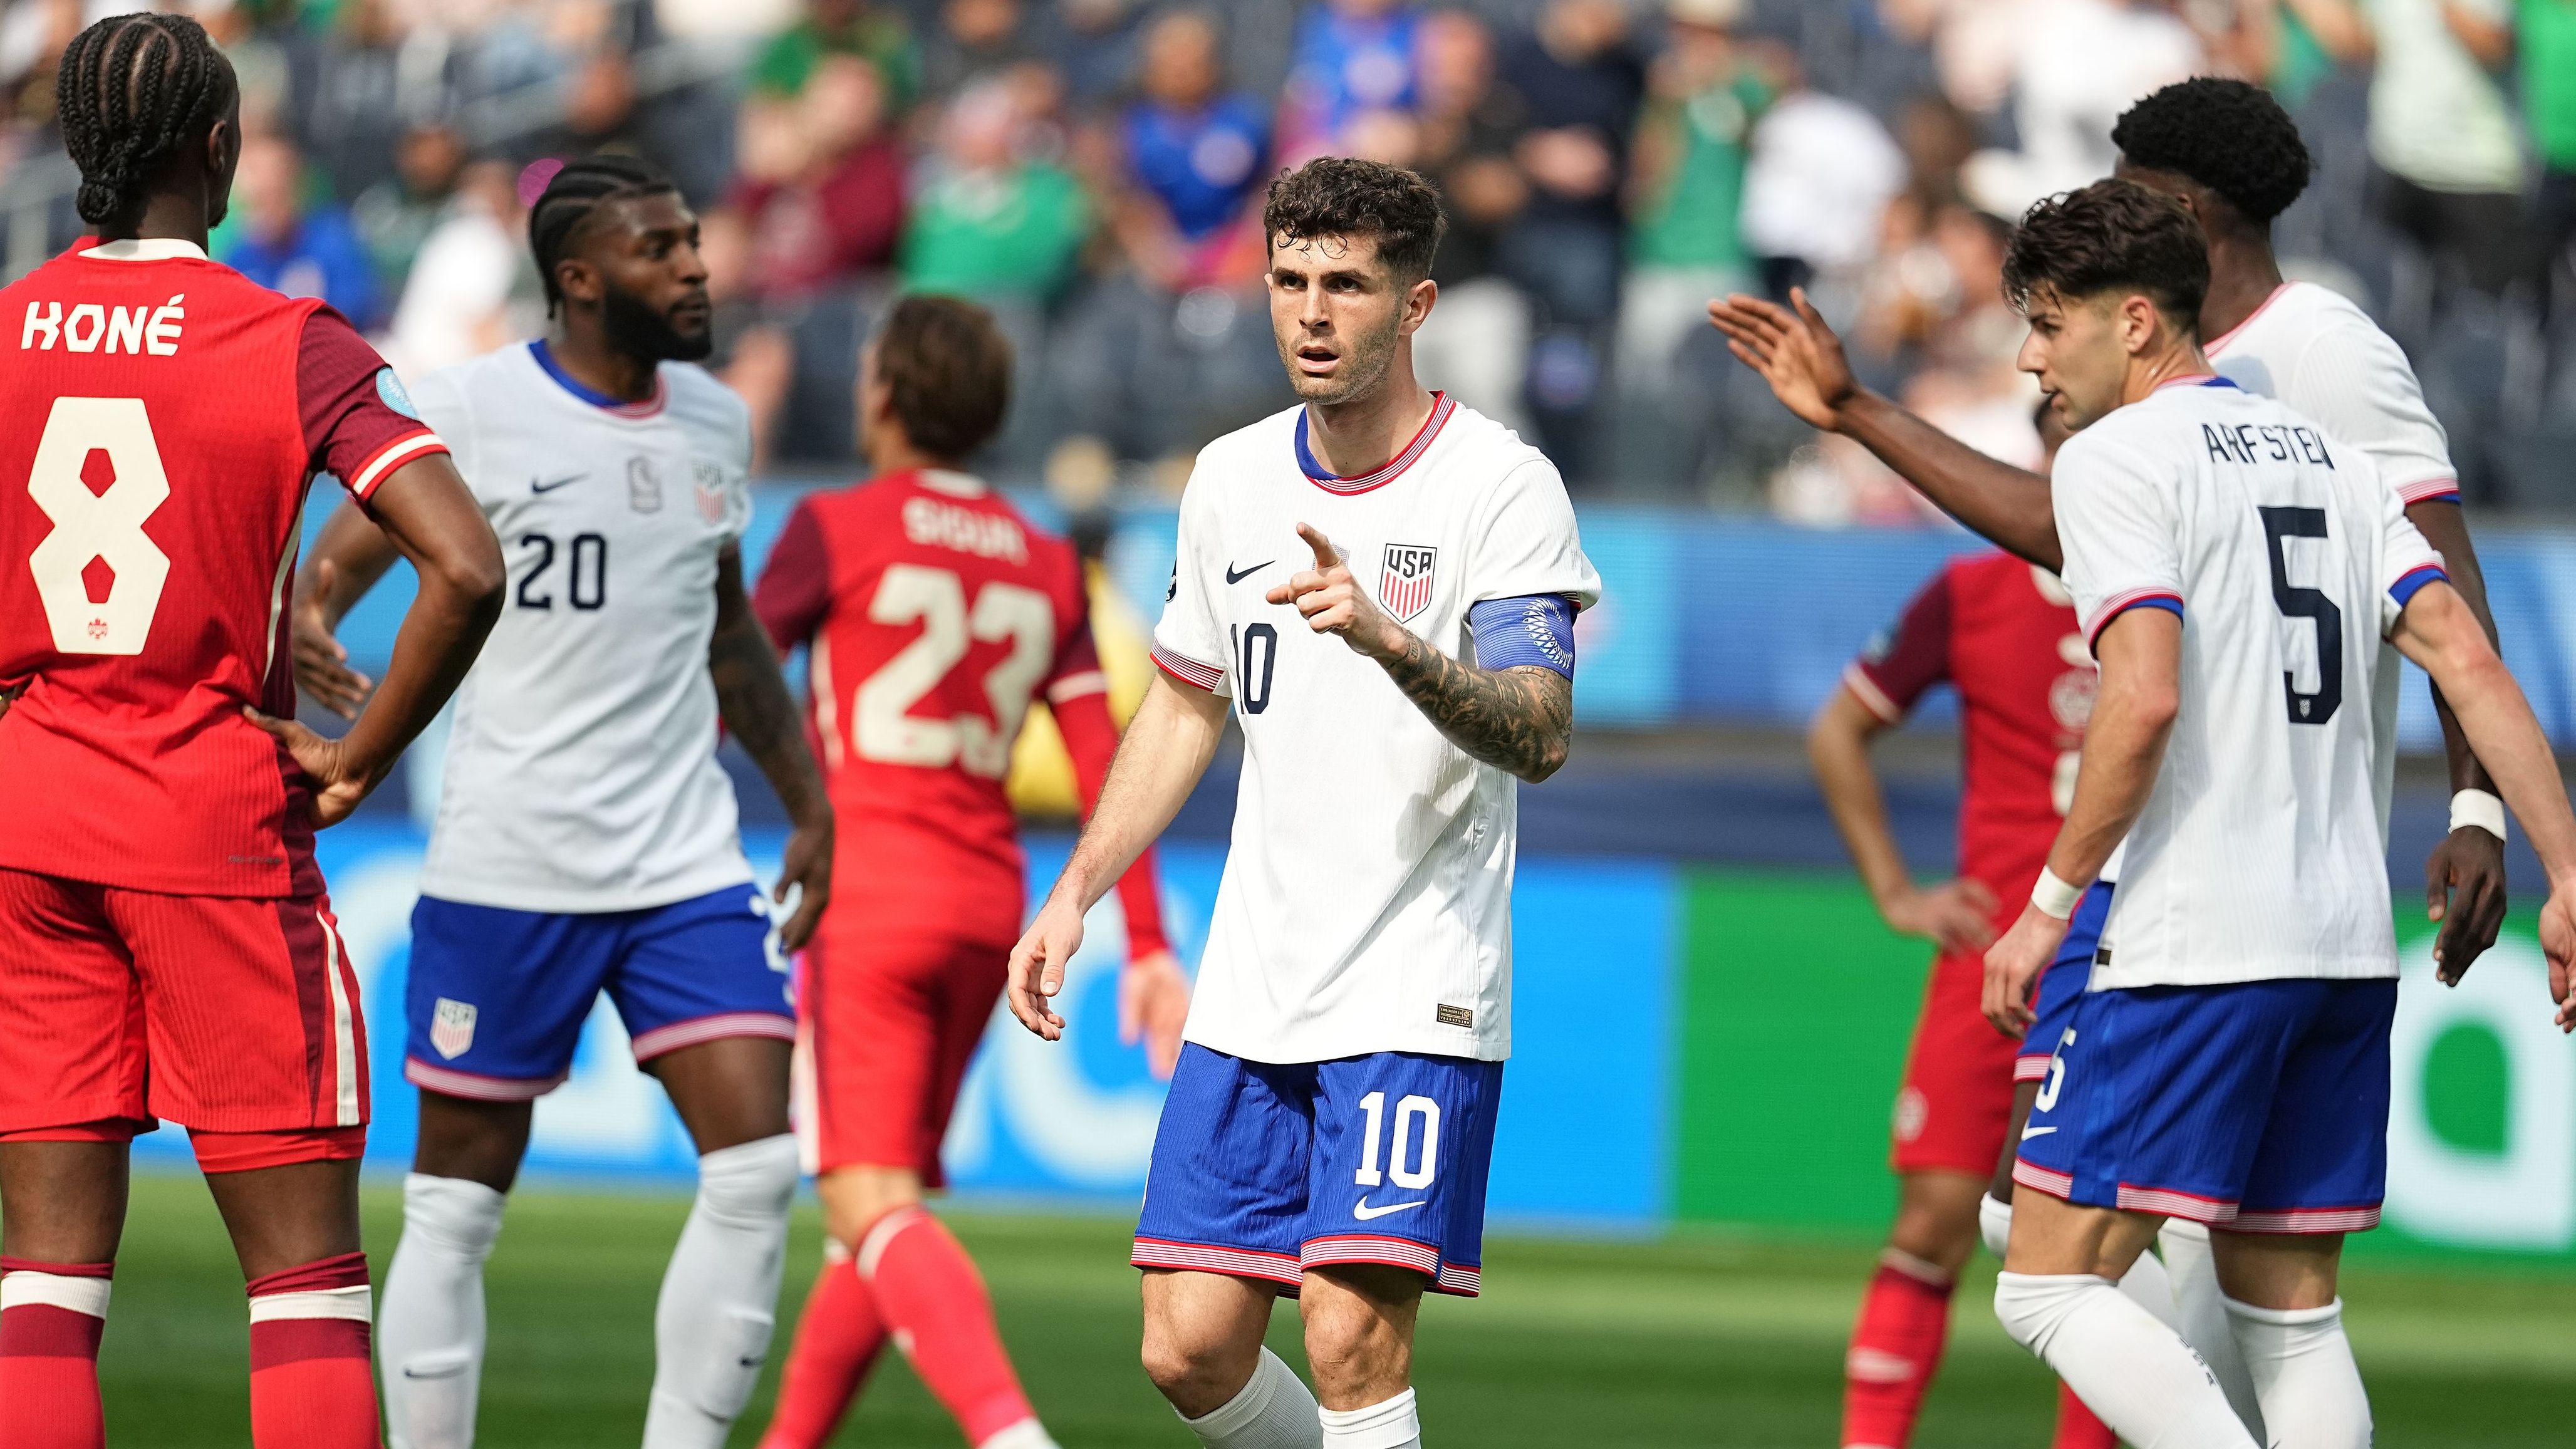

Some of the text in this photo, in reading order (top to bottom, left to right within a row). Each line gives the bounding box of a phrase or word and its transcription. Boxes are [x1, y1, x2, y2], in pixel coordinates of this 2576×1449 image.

[21, 293, 185, 356] KONÉ
[2201, 423, 2335, 470] ARFSTEN
[28, 397, 170, 655] 8
[1388, 549, 1432, 578] USA
[518, 534, 605, 610] 20
[2257, 506, 2342, 725] 5
[852, 563, 1056, 781] 23
[1230, 623, 1277, 714] 10
[2035, 1026, 2077, 1113] 5
[1355, 1091, 1440, 1189] 10
